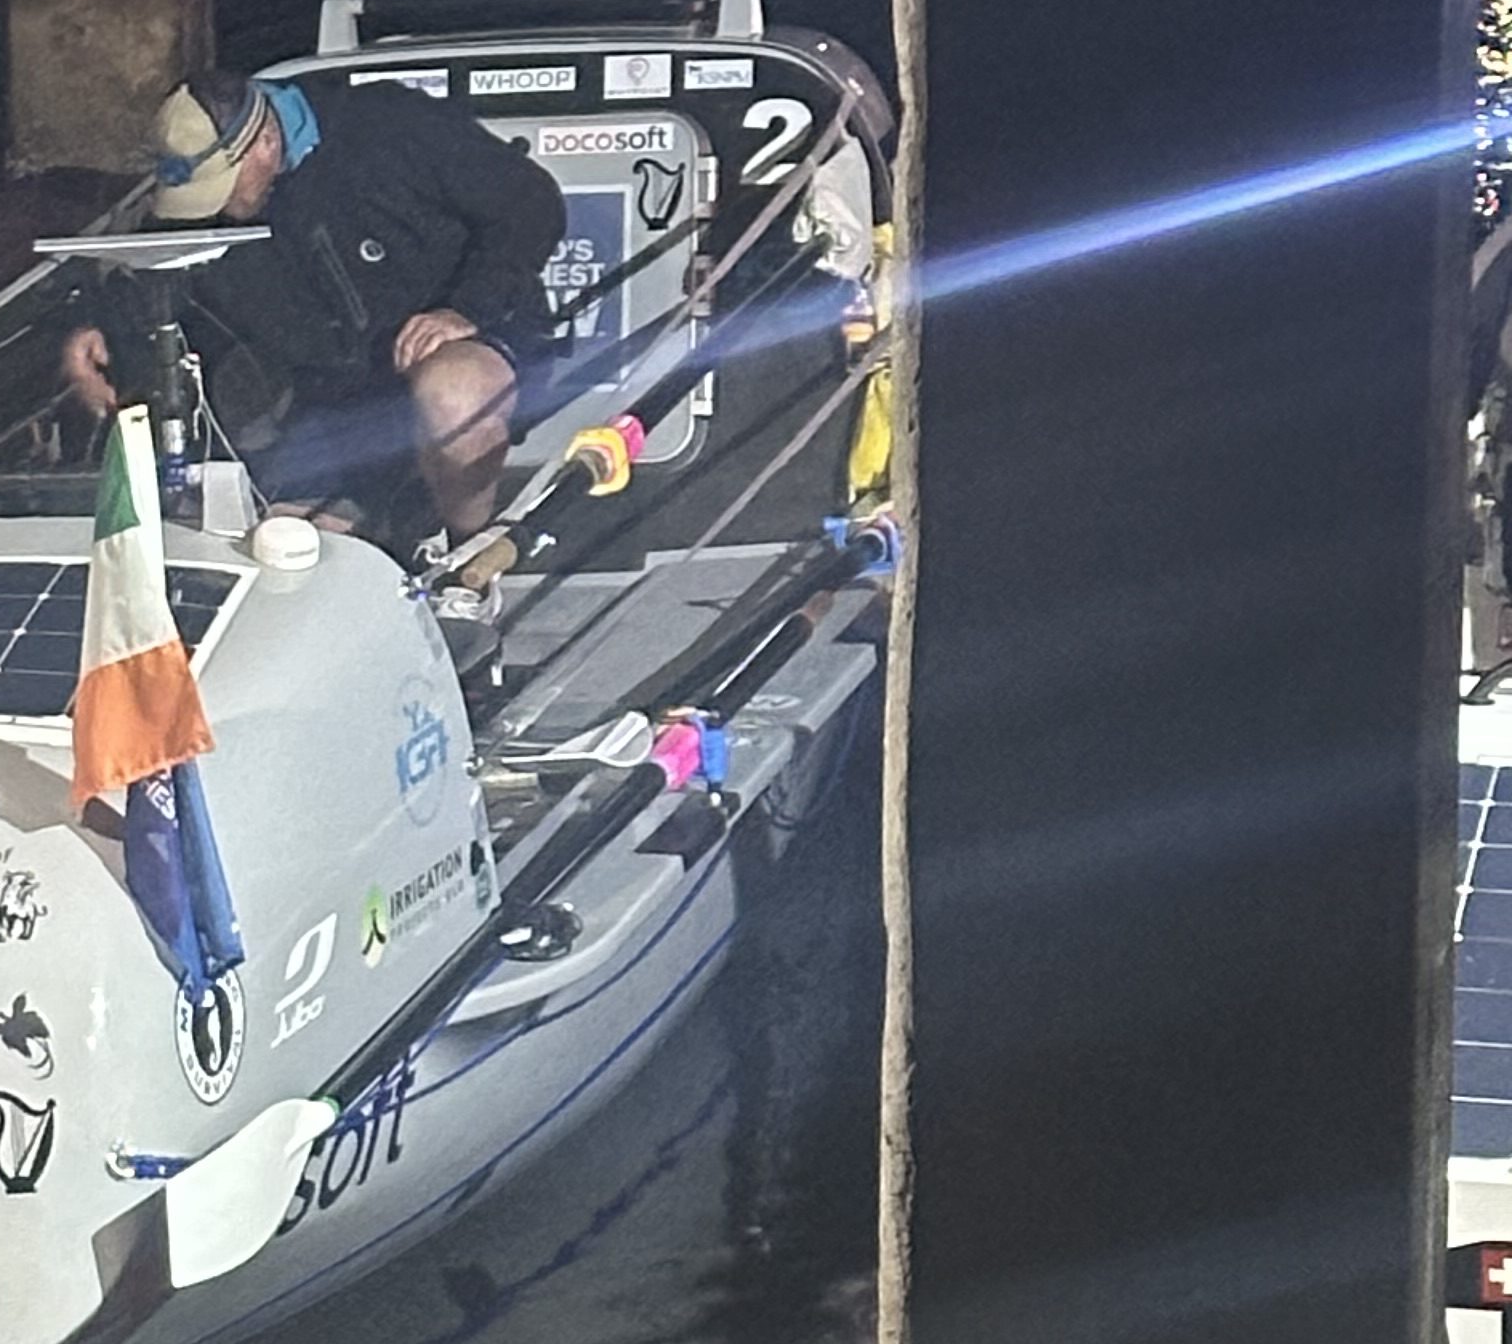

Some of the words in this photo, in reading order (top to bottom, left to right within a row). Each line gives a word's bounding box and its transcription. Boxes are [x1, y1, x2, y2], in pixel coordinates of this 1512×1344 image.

[473, 71, 571, 90] WHOOP
[740, 97, 812, 185] 2
[389, 845, 463, 920] IRRIGATION
